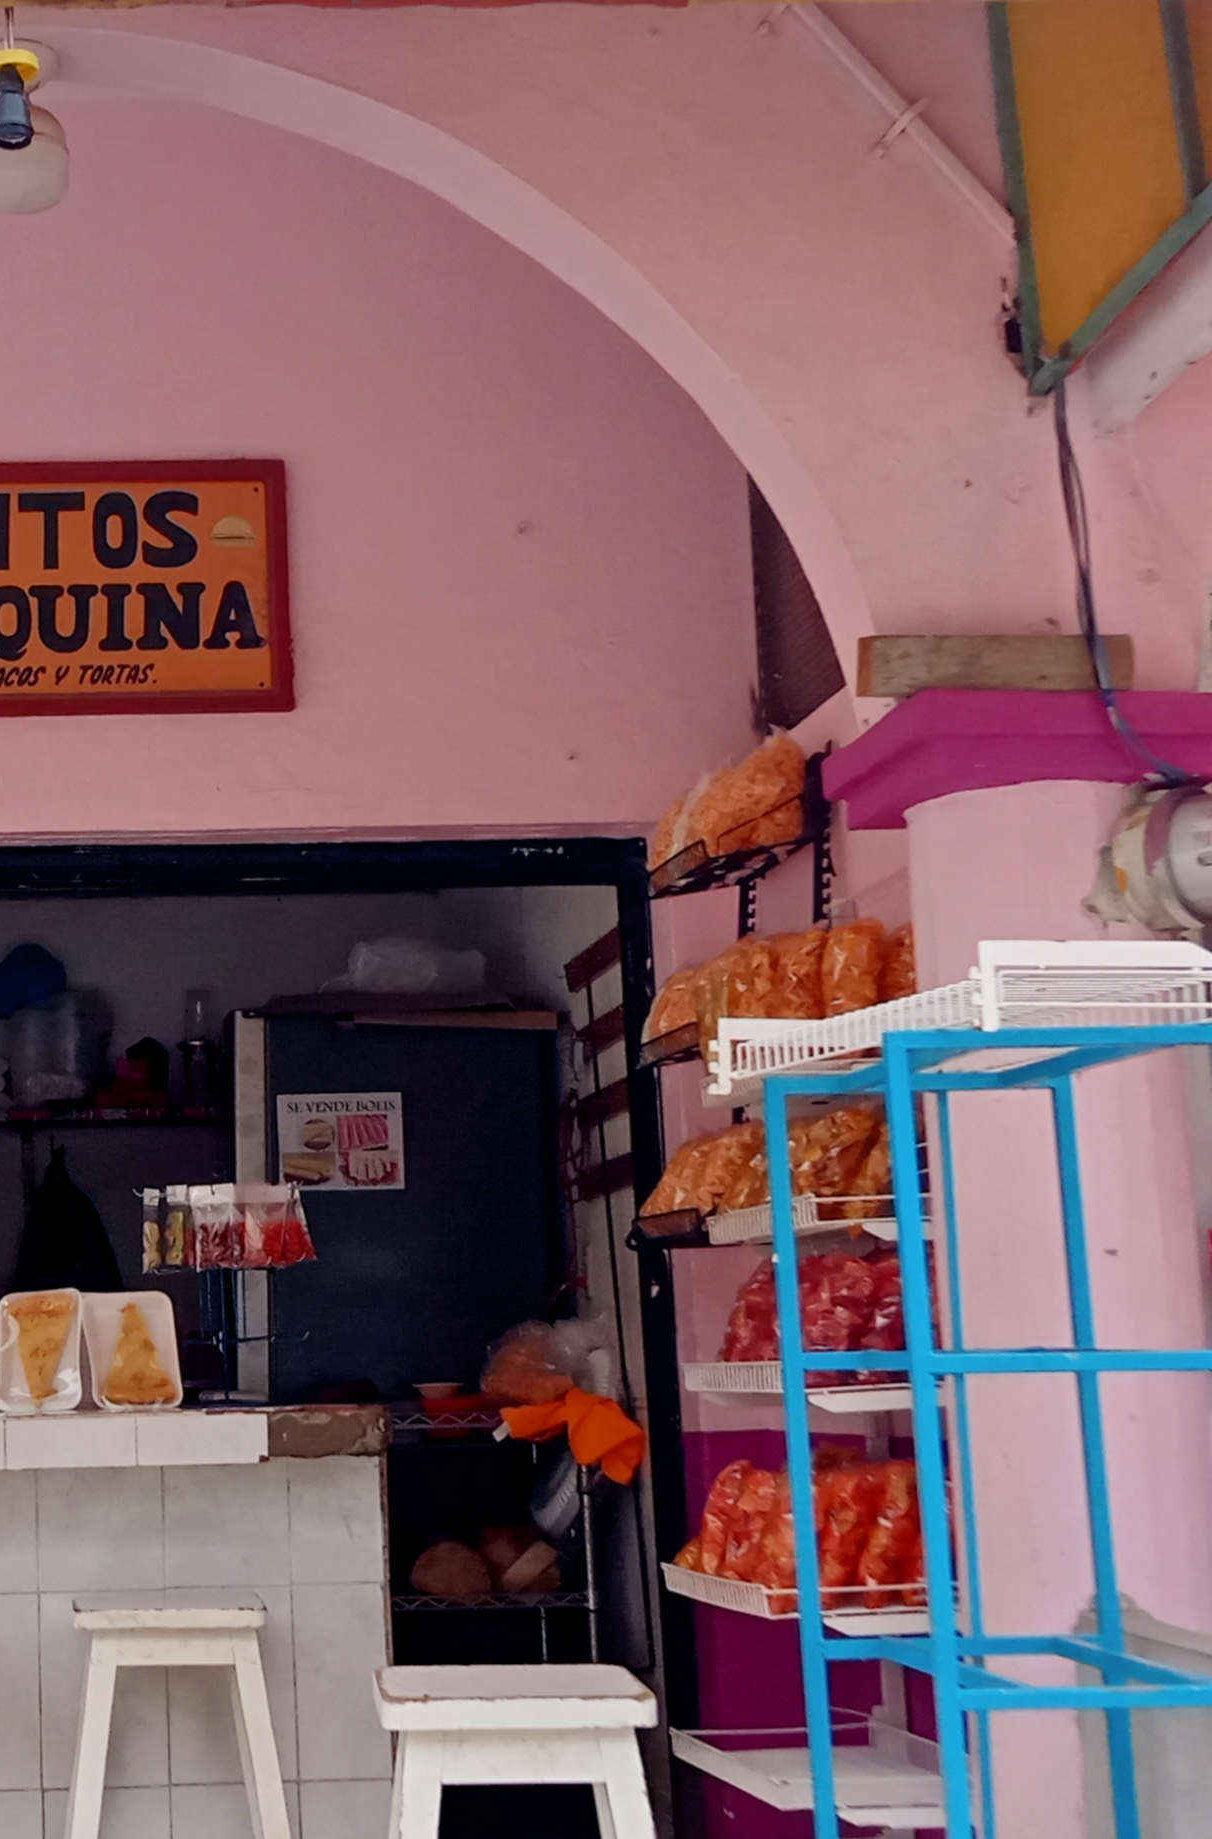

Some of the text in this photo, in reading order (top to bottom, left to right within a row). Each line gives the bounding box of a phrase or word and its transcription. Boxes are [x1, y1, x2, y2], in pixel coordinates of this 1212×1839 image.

[54, 664, 70, 685] Y
[78, 663, 159, 685] TORTAS.
[287, 1100, 396, 1114] SE VENDE BOLIS
